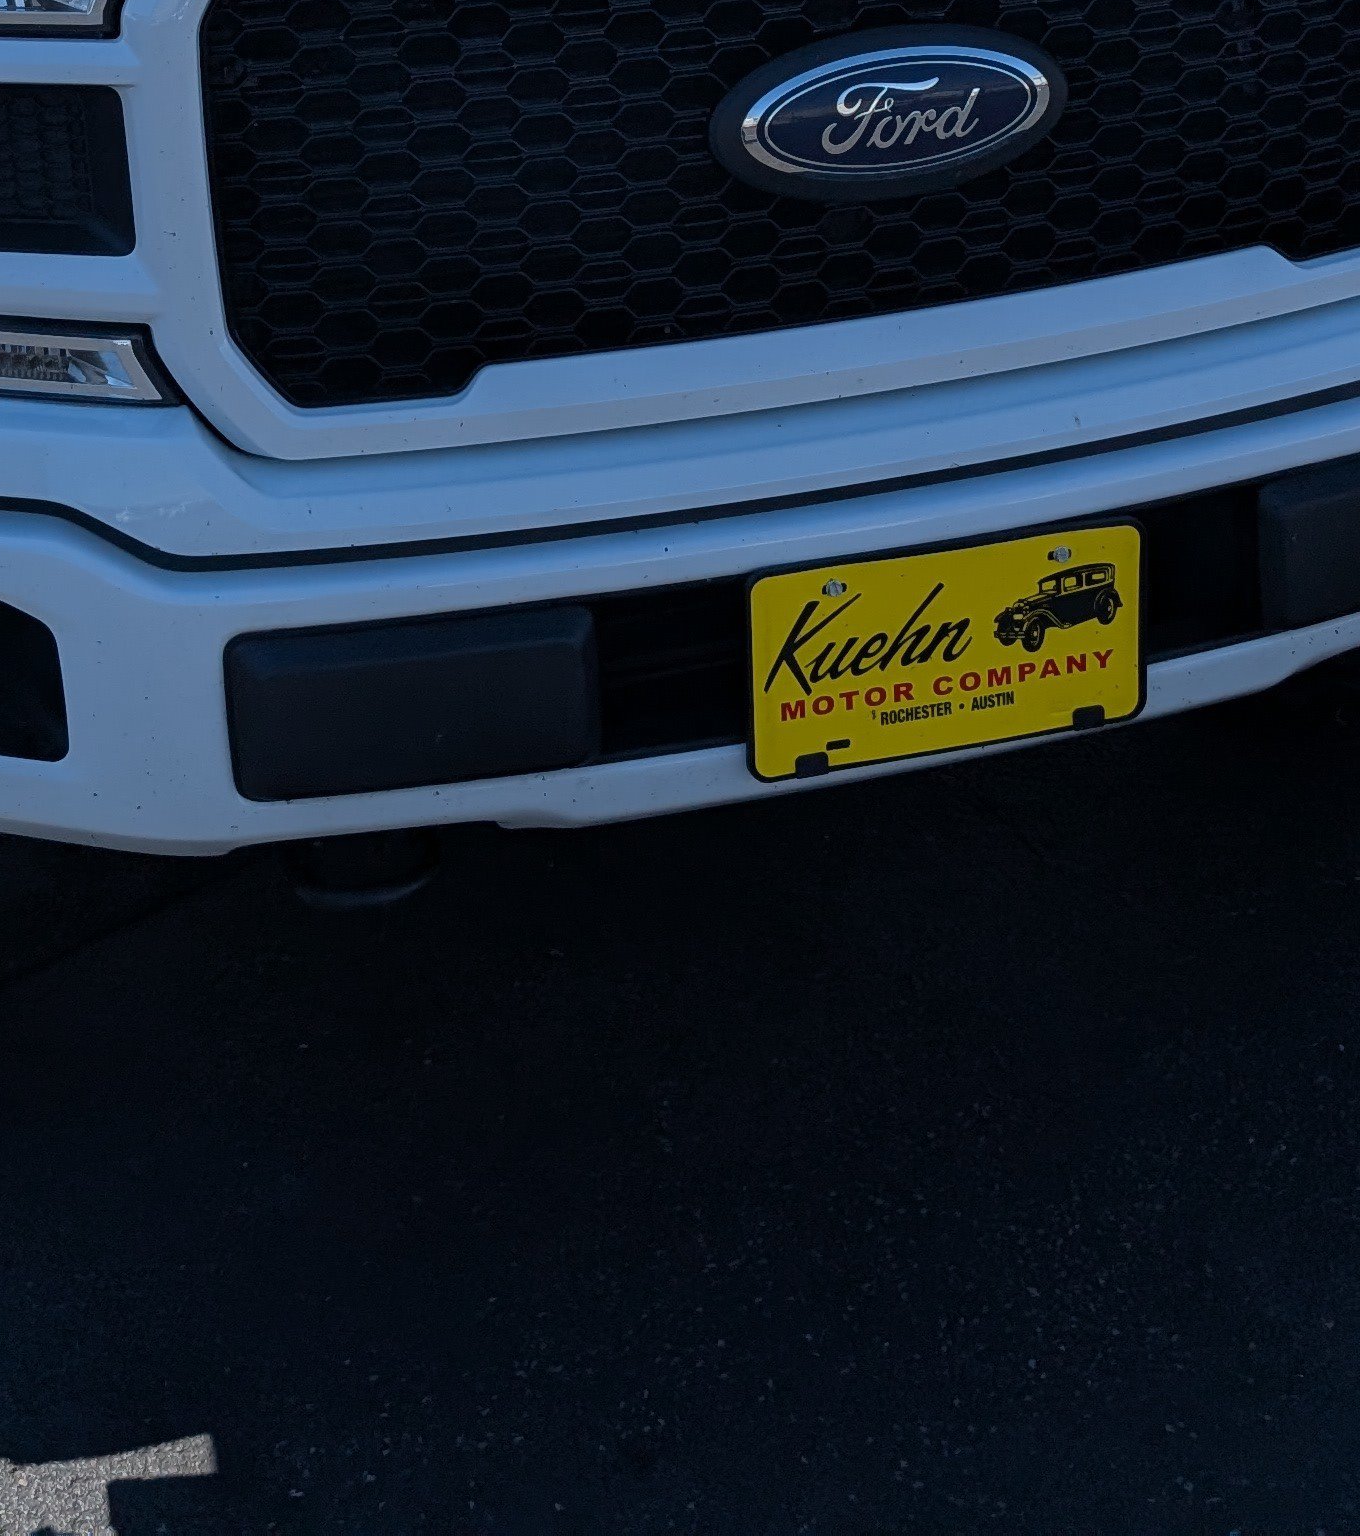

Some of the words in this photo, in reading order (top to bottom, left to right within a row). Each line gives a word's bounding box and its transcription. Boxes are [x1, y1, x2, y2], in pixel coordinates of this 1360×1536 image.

[821, 76, 980, 155] Ford
[764, 582, 973, 696] Kuehn
[780, 682, 915, 722] MOTOR
[933, 648, 1114, 696] COMPANY
[880, 701, 953, 726] ROCHESTER
[971, 690, 1015, 712] AUSTIN
